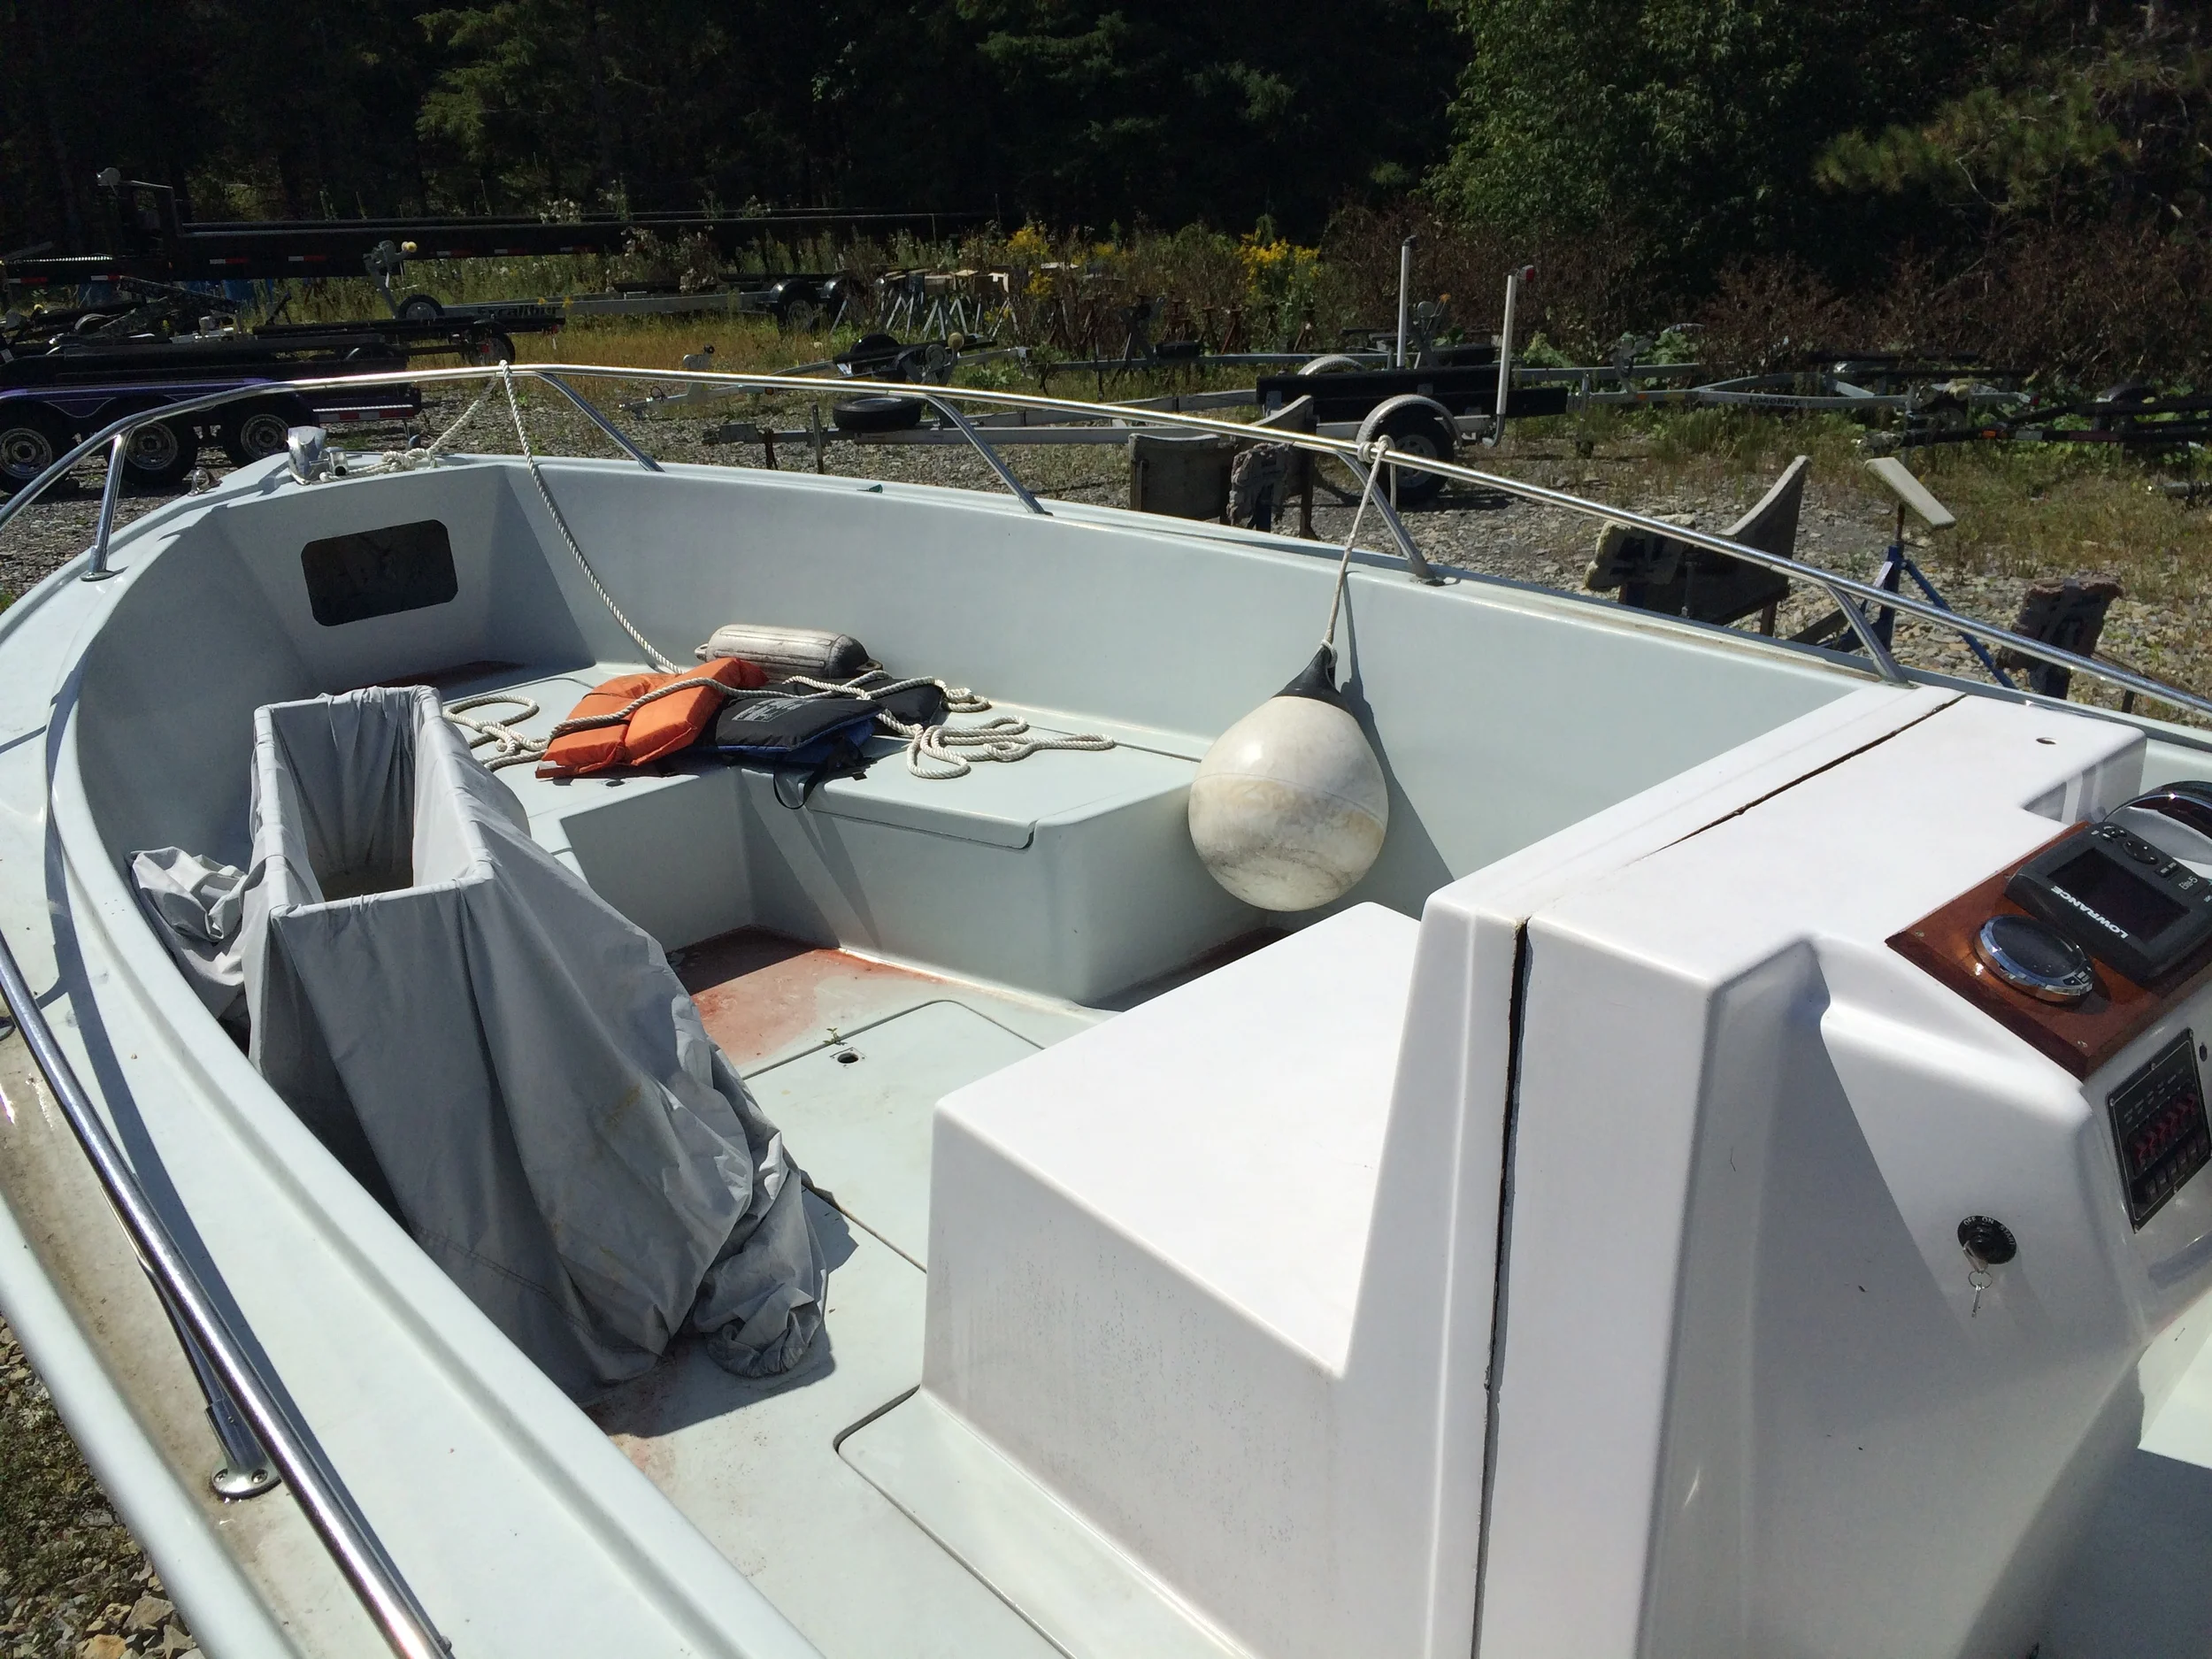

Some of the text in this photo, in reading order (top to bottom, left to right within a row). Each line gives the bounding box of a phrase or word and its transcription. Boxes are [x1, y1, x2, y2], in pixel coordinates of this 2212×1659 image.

[2051, 885, 2129, 940] LOWRANCE
[1963, 1217, 2016, 1246] OFF ON START
